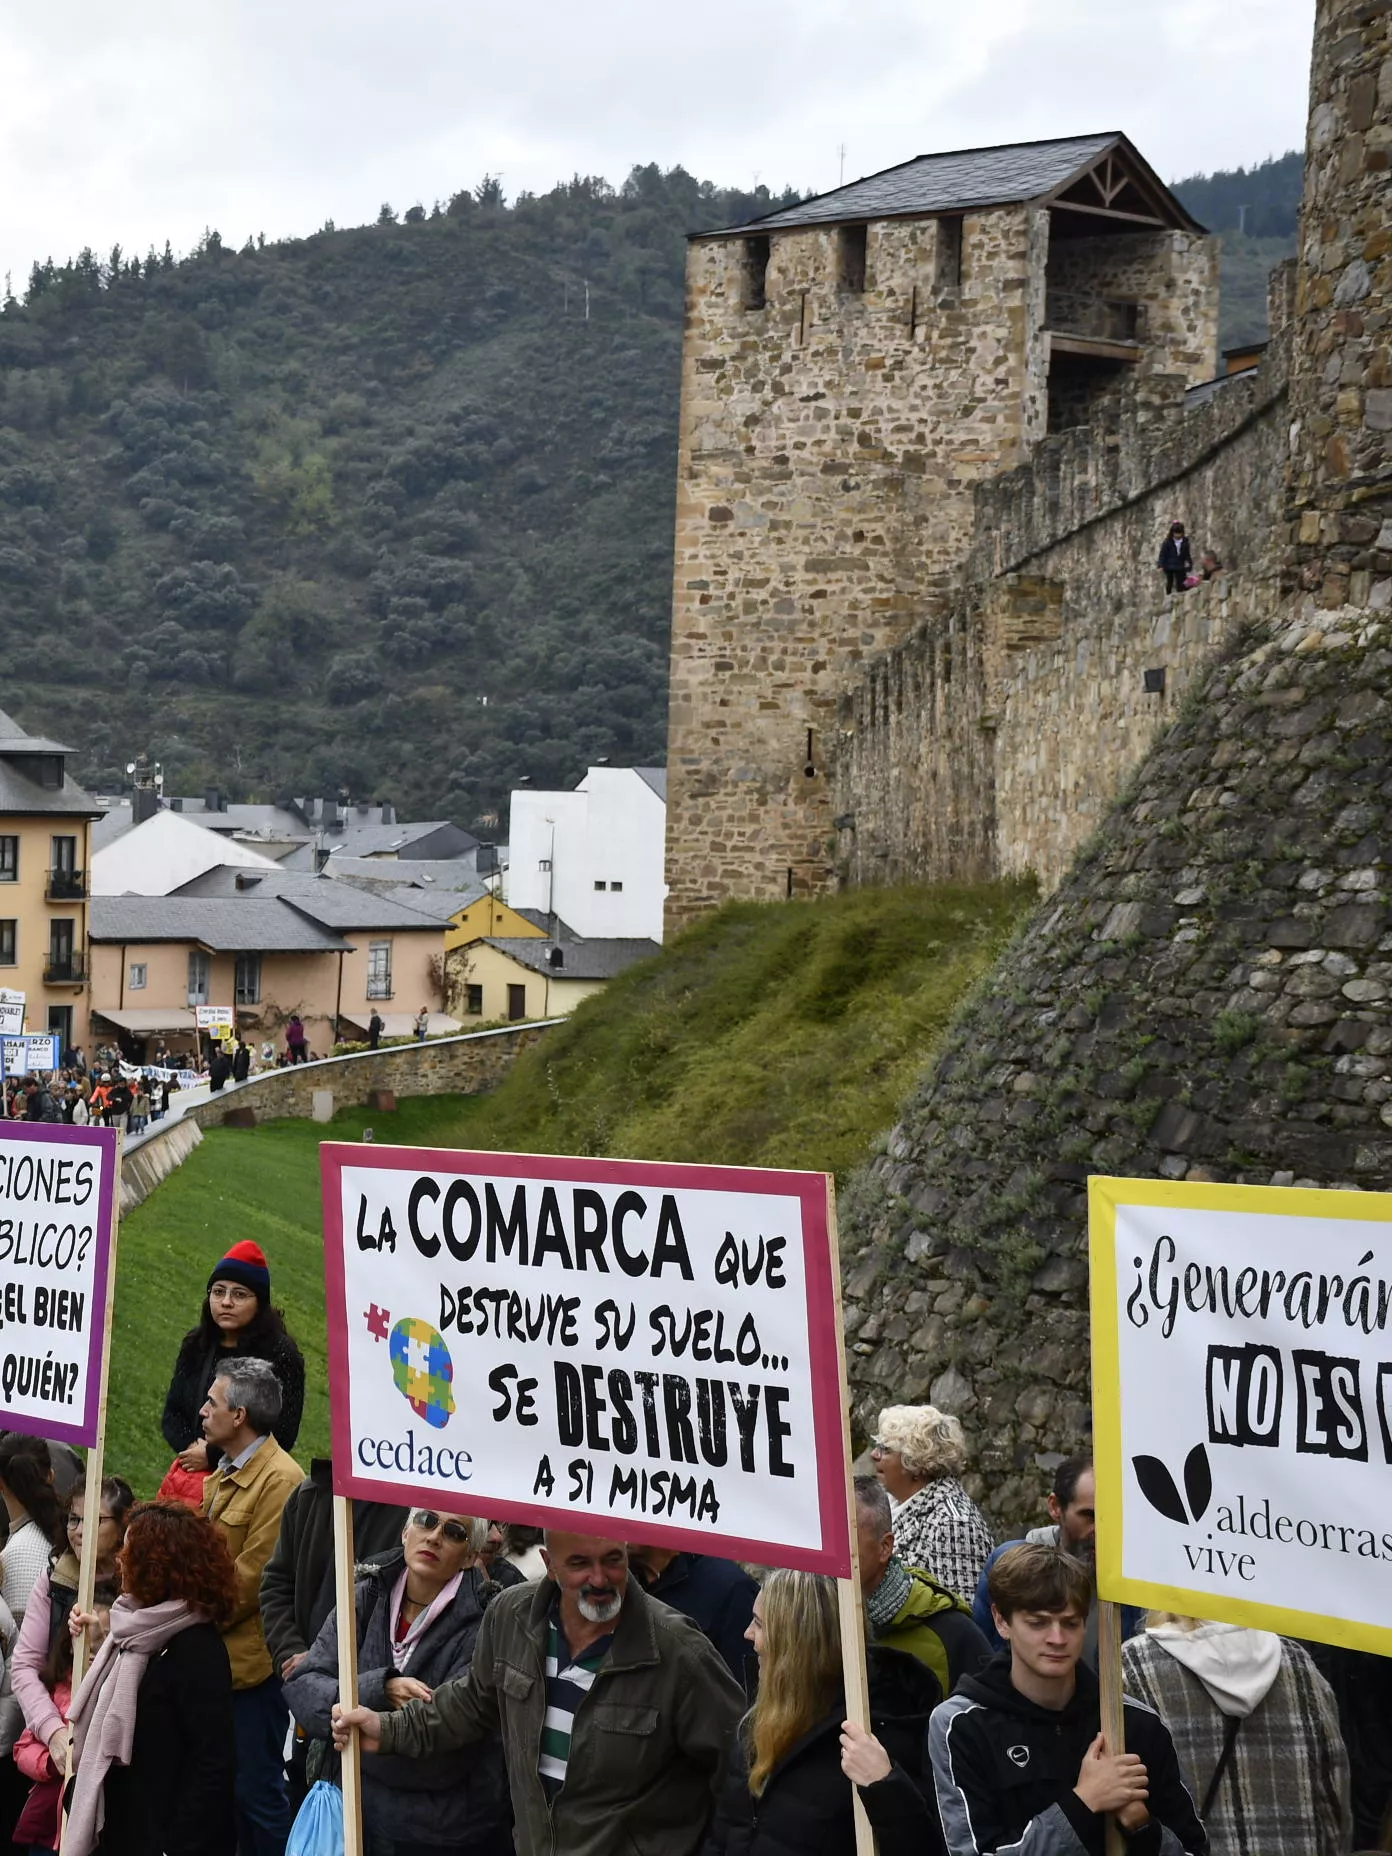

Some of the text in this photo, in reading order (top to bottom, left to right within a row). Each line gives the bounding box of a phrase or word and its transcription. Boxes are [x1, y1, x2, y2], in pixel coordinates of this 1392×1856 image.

[356, 1176, 787, 1290] LA COMARCA QUE
[34, 1286, 85, 1333] BIEN
[439, 1283, 789, 1371] DESTRUYE SU SUELO...
[2, 1351, 80, 1404] QUIÉN?
[1208, 1350, 1281, 1442] NO
[1298, 1358, 1364, 1455] ES
[488, 1361, 795, 1479] SE DESTRUYE
[357, 1430, 473, 1482] cedace
[533, 1454, 720, 1524] A SI MISMA
[1183, 1533, 1256, 1581] vive
